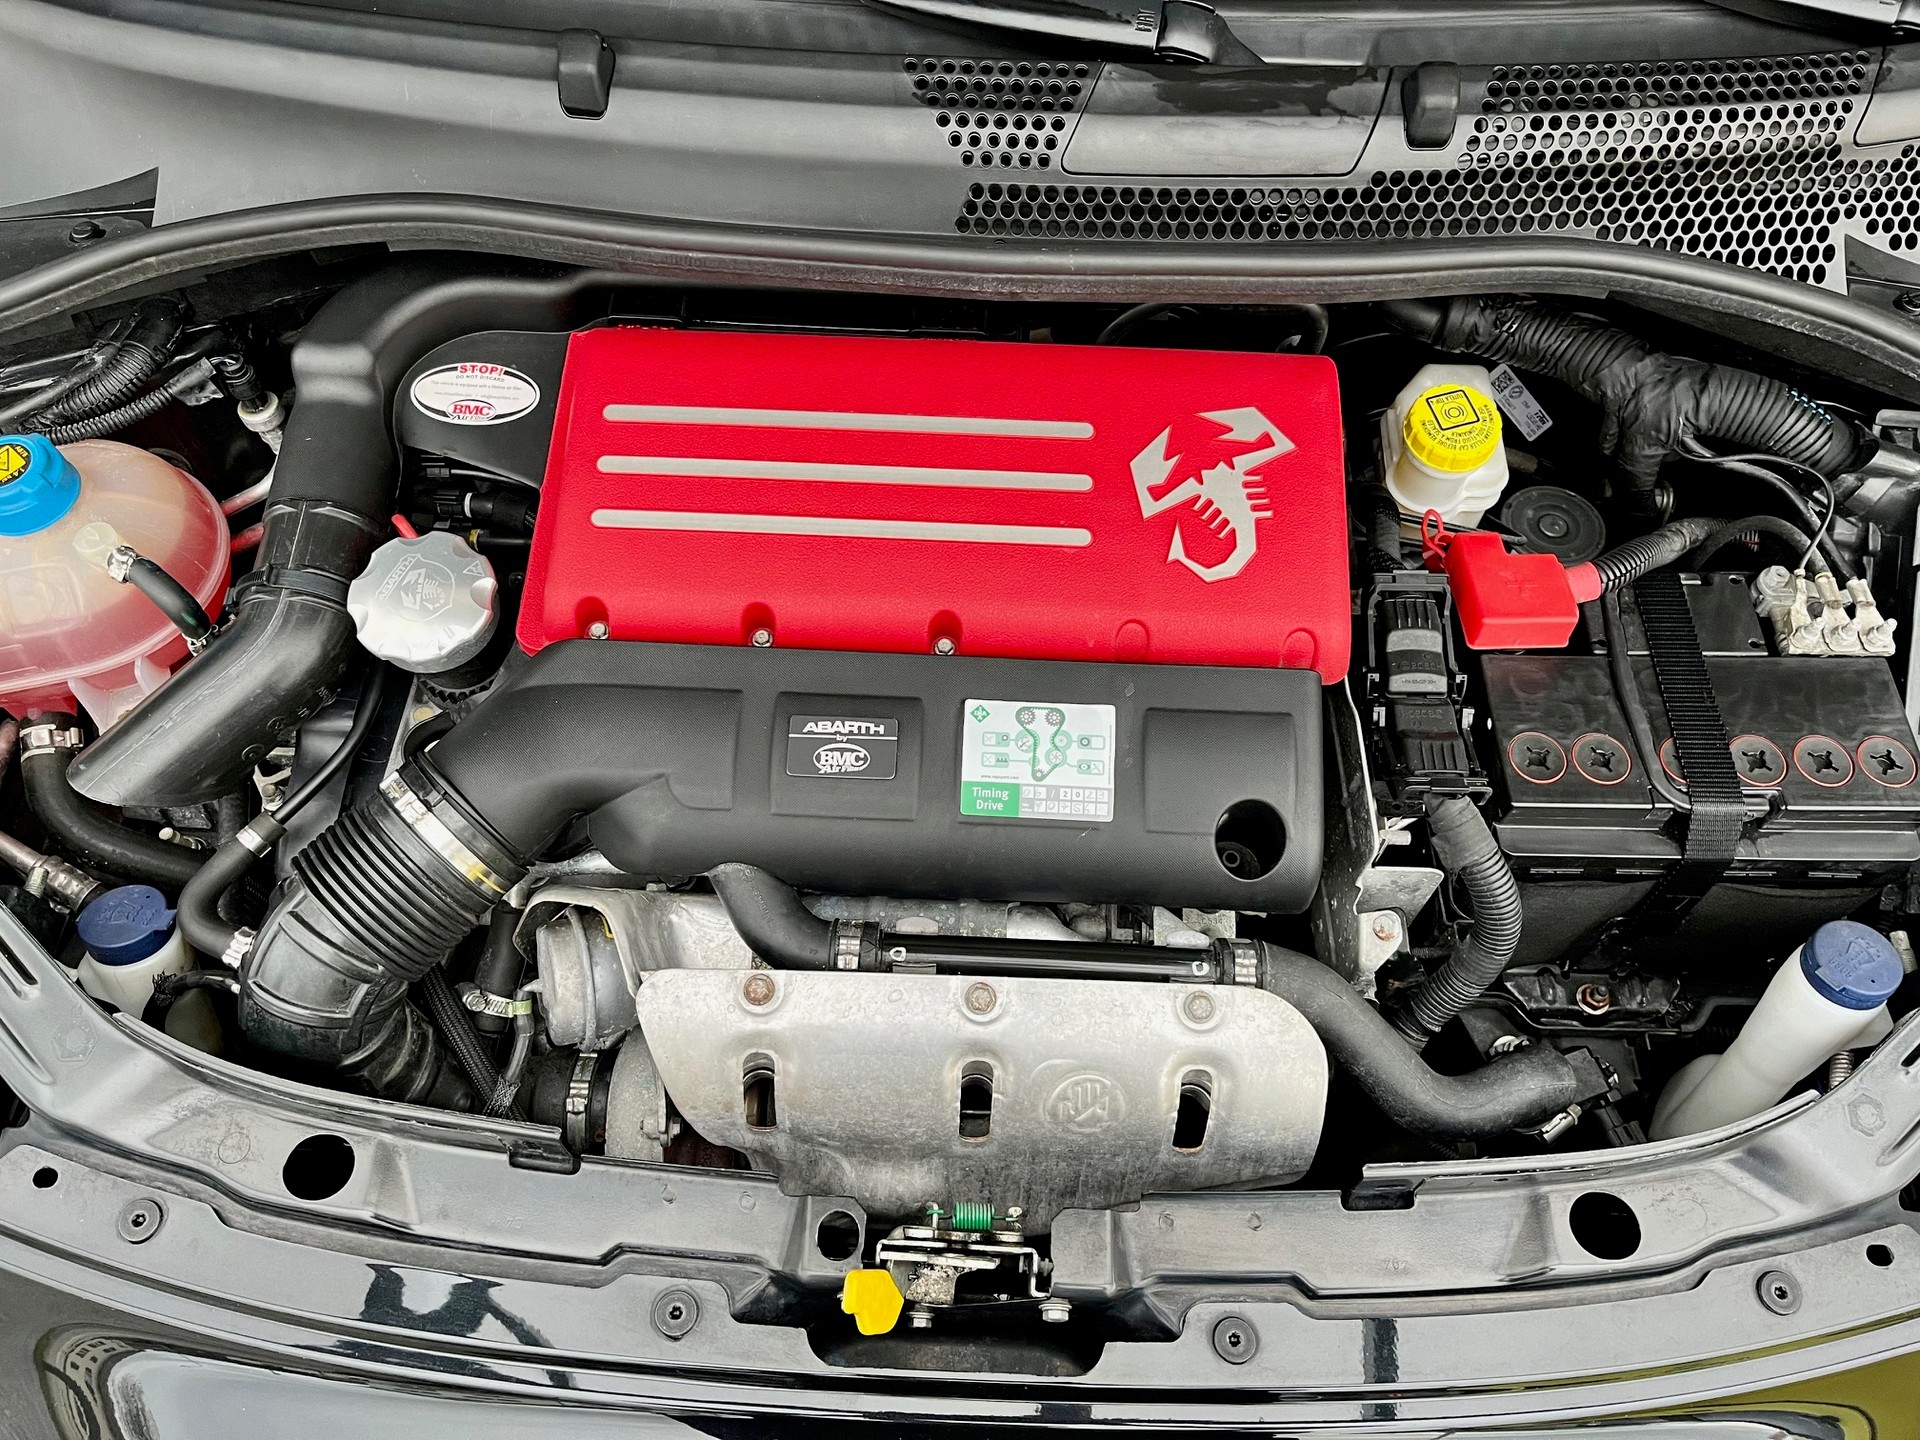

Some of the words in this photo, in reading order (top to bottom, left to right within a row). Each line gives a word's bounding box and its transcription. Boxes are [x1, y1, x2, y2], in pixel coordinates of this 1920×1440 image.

[459, 365, 504, 376] STOP!
[452, 403, 492, 416] BMC
[1437, 439, 1457, 450] BEFORE
[1446, 436, 1461, 444] FROM
[1470, 438, 1486, 449] FILLER
[380, 557, 413, 599] ABARTH
[802, 720, 885, 735] ABARTH
[836, 733, 848, 742] by
[820, 751, 865, 767] BMC
[972, 786, 1009, 800] Timing
[976, 799, 1004, 811] Drive
